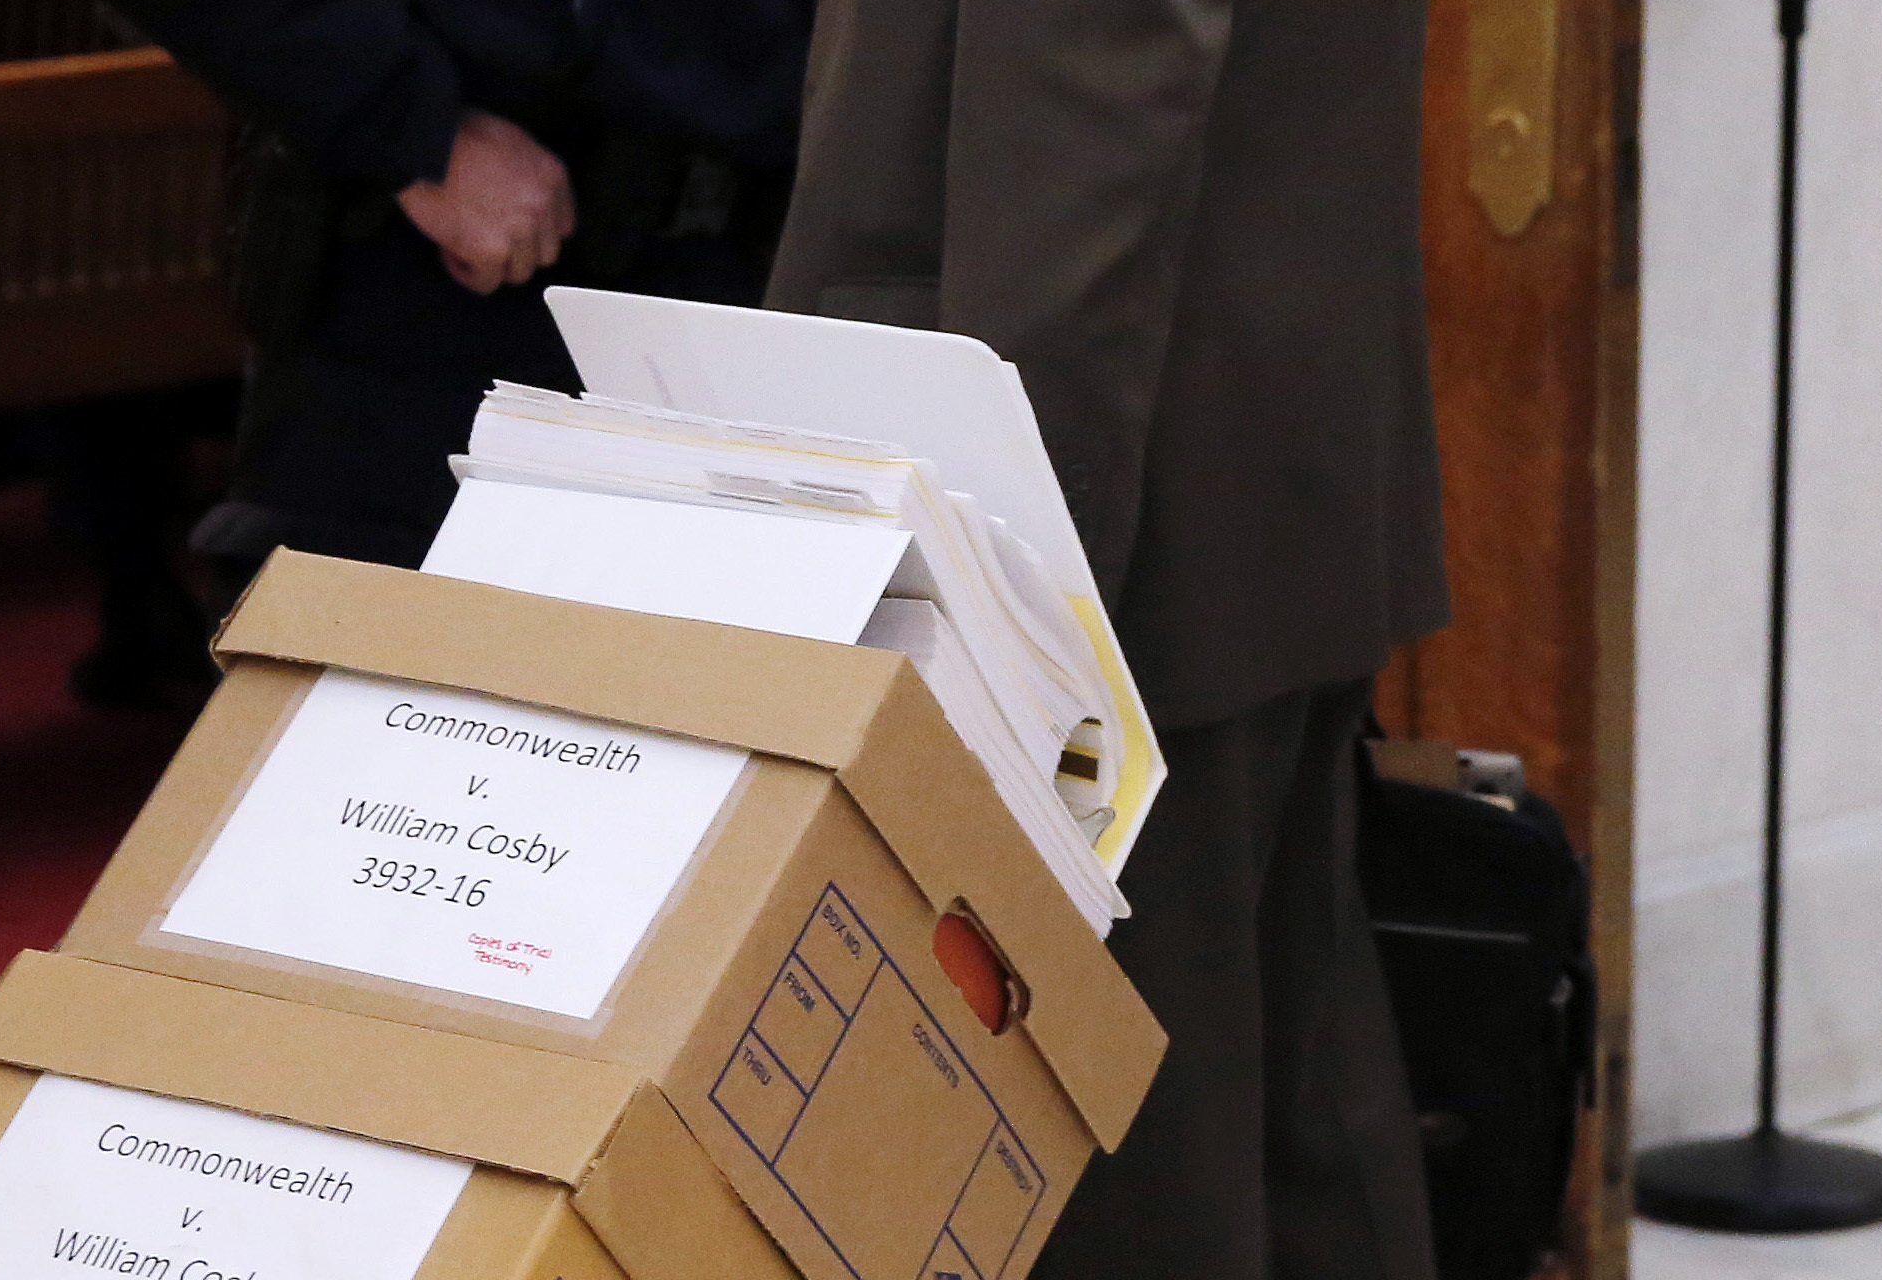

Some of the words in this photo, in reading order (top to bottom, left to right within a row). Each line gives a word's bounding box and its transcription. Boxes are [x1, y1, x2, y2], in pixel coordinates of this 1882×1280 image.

[385, 702, 642, 775] Commonwealth
[467, 774, 488, 800] v.
[340, 798, 456, 847] William
[468, 825, 568, 876] Cosby
[353, 857, 492, 909] 3932-16
[821, 904, 847, 933] BOX
[784, 972, 815, 1011] FROM
[743, 1045, 771, 1086] THRU
[98, 1123, 353, 1205] Commonwealth
[181, 1206, 202, 1232] v.
[53, 1227, 169, 1280] William
